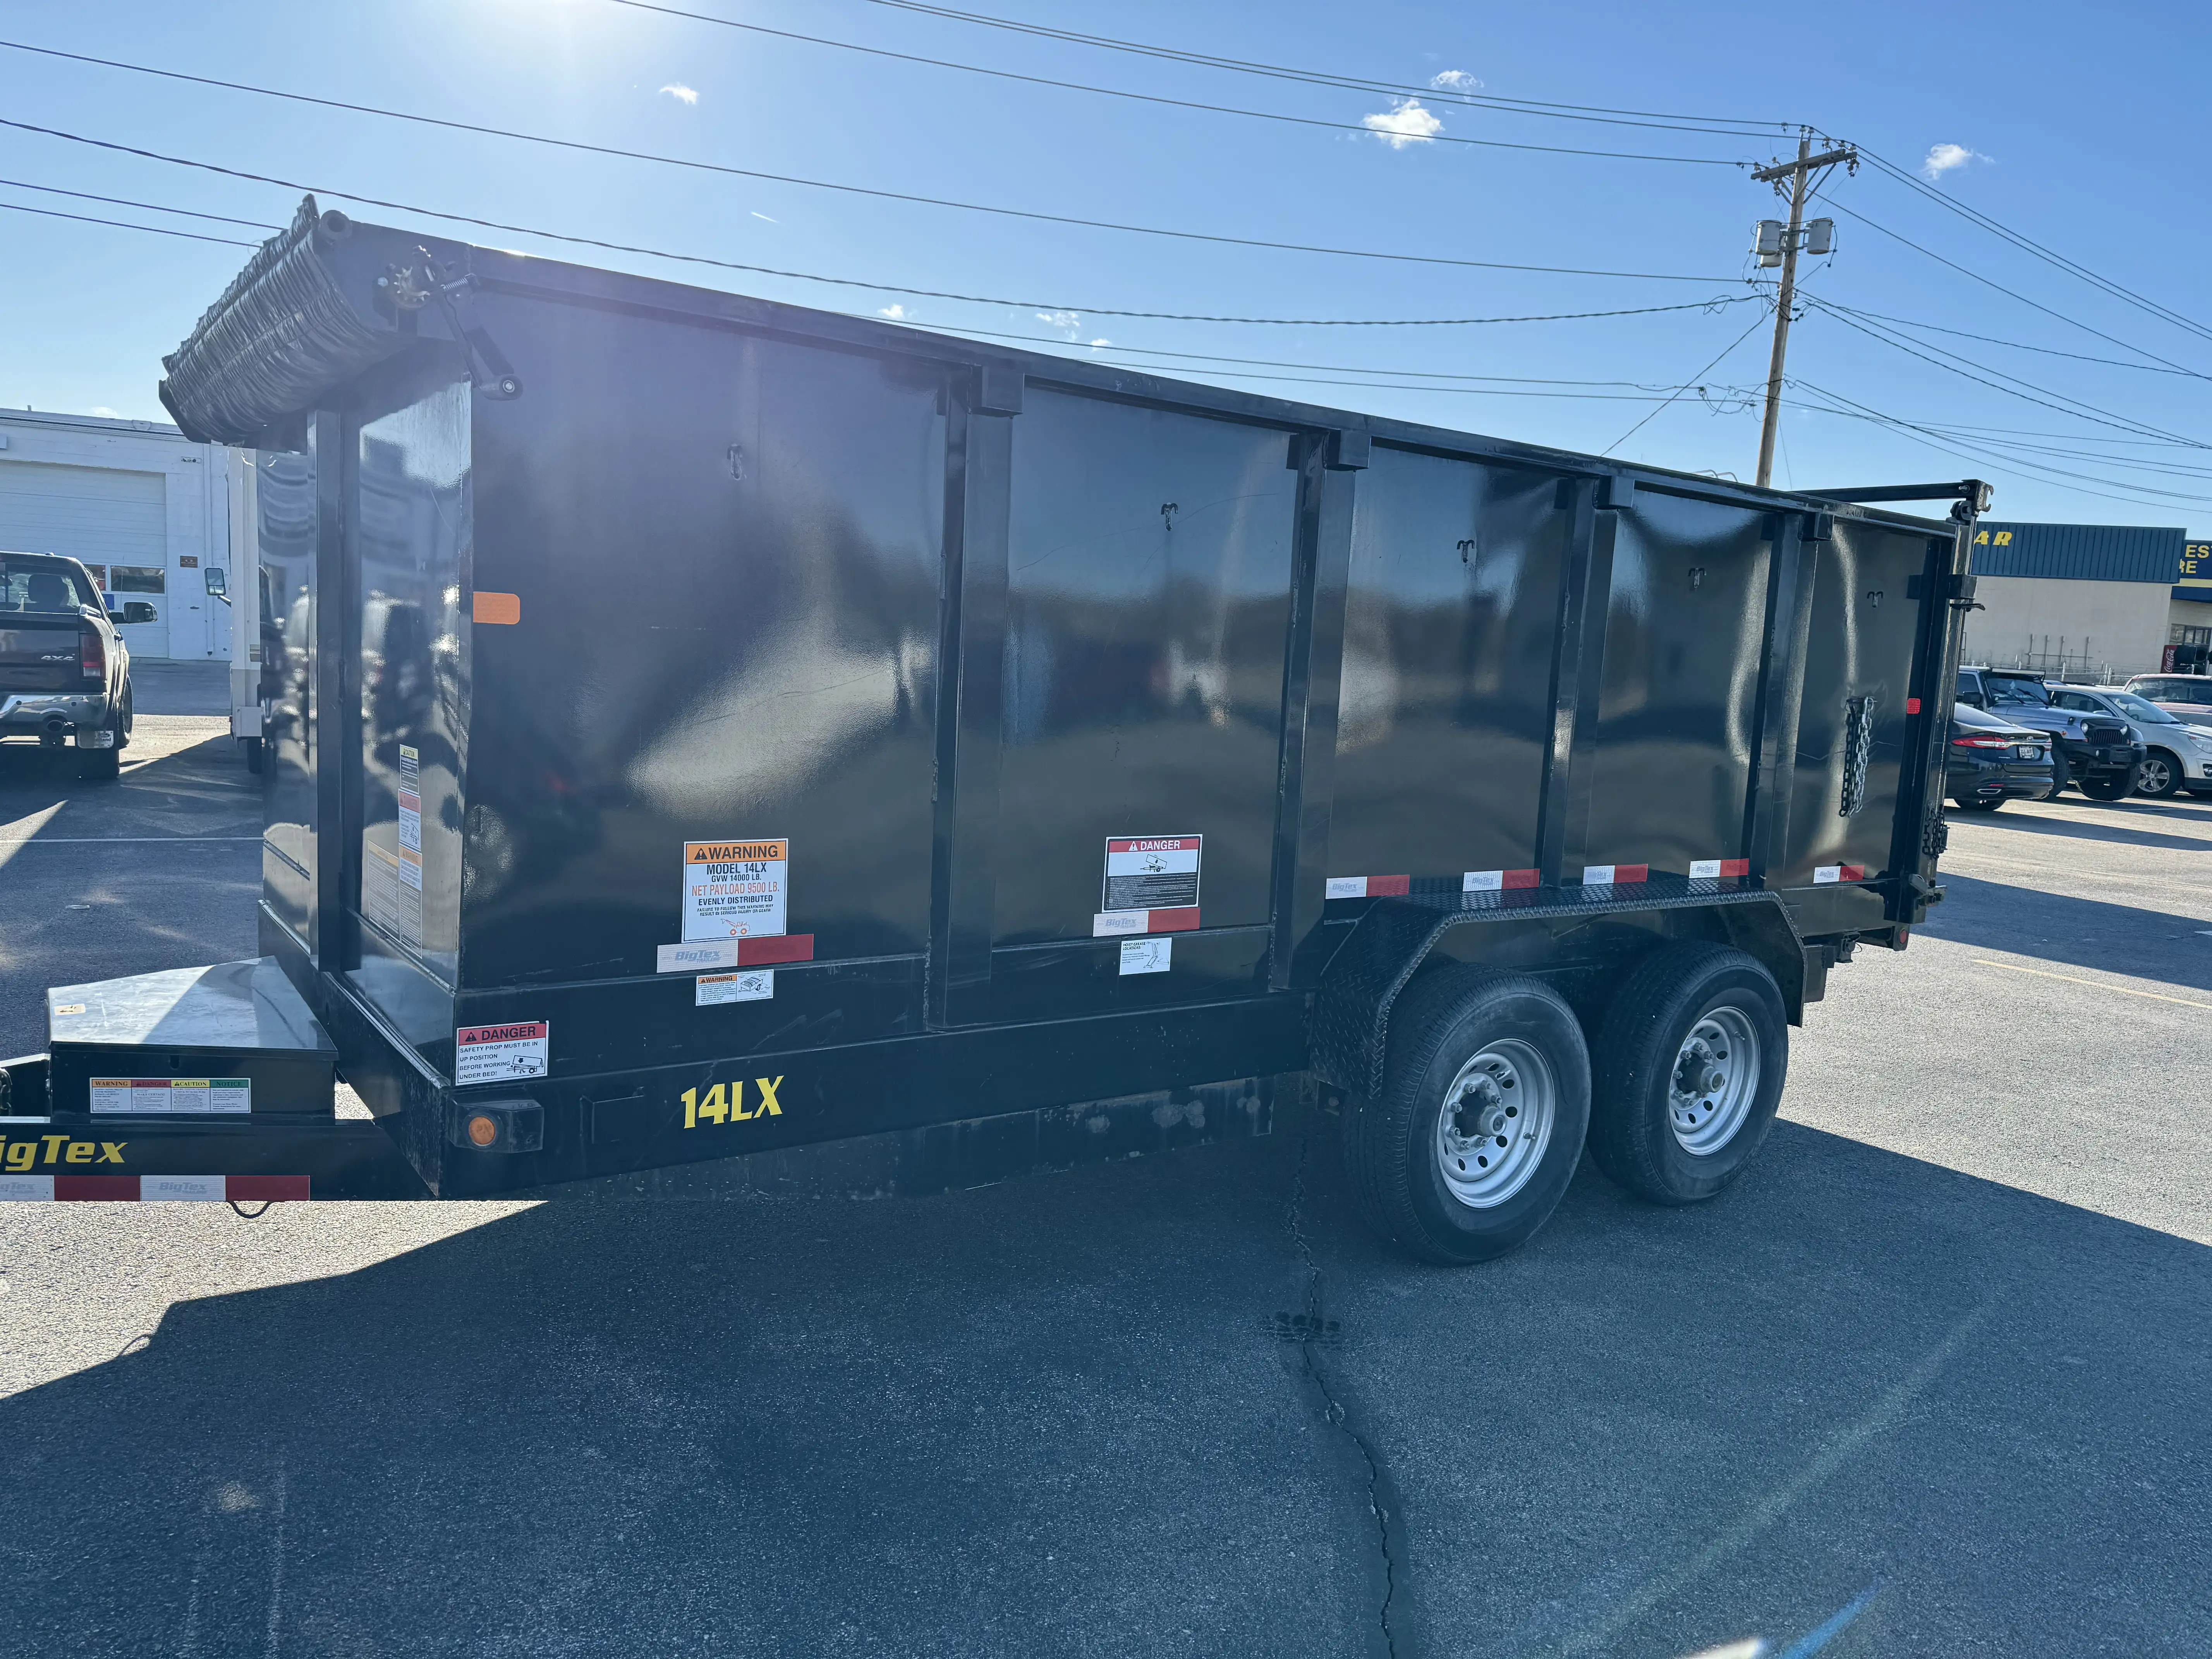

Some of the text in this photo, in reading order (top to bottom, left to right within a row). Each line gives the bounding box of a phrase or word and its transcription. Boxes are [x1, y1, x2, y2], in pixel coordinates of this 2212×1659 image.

[2185, 545, 2212, 558] ES
[1140, 840, 1180, 850] DANGER
[708, 845, 778, 860] WARNING
[707, 862, 767, 875] MODEL 14LX
[692, 882, 779, 896] NET PAYLOAD 9500 LB.
[699, 895, 773, 906] EVENLY DISTRIBUTED
[675, 950, 720, 961] BigTex
[482, 1026, 536, 1041] DANGER
[681, 1075, 784, 1129] 14LX
